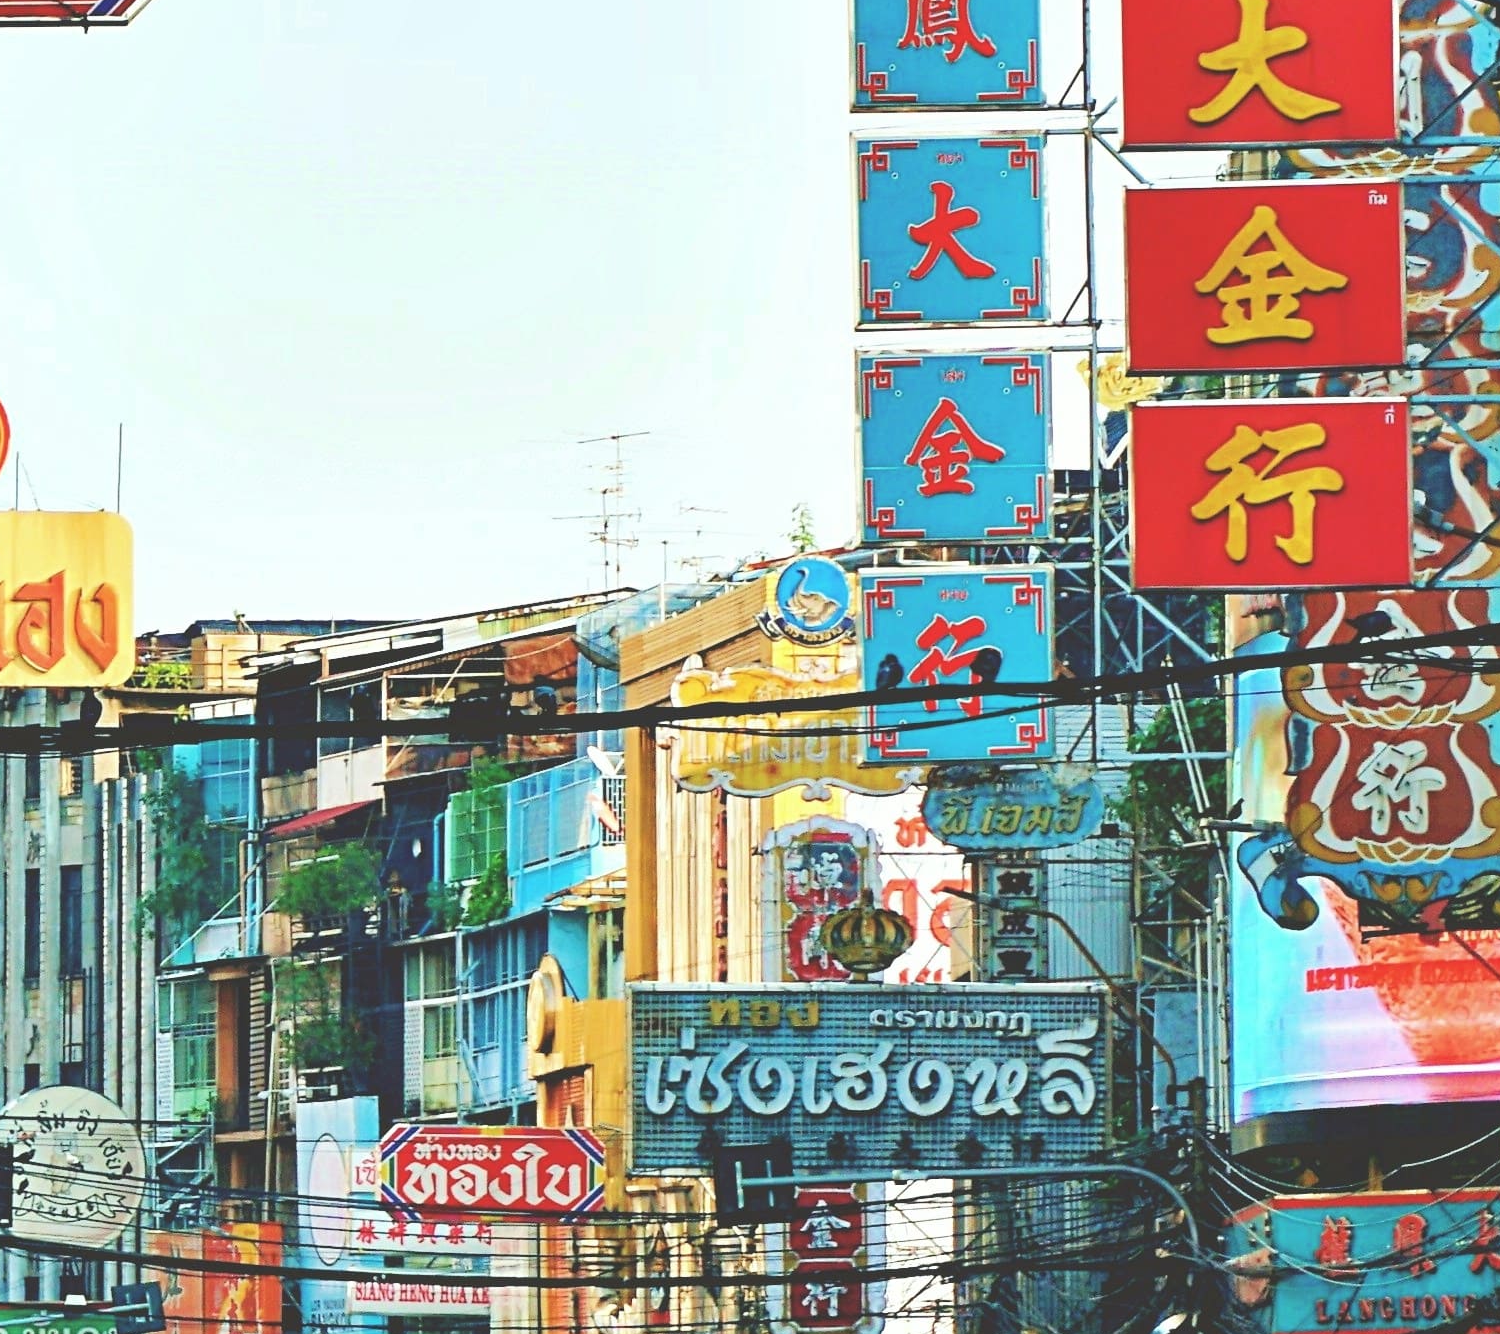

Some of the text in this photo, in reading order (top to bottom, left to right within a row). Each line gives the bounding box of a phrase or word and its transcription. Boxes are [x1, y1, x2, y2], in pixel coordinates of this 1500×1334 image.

[709, 993, 820, 1029] ทอง
[401, 1141, 584, 1207] ทองใบ
[355, 1279, 395, 1303] SIANG
[399, 1279, 436, 1304] HENG
[439, 1279, 468, 1303] HUA
